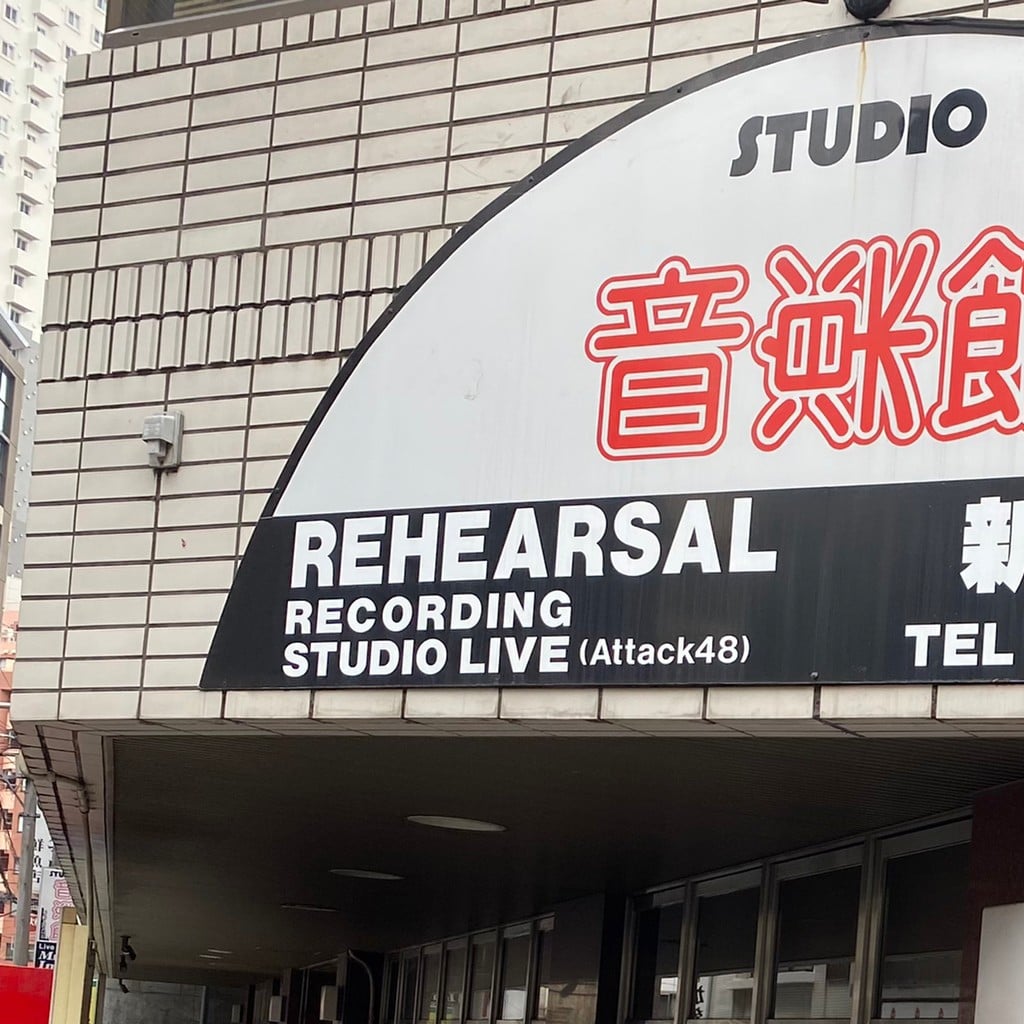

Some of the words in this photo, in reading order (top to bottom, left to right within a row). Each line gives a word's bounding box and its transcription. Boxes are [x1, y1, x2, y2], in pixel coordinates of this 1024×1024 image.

[729, 88, 987, 177] STUDIO
[291, 497, 778, 589] REHEARSAL
[284, 591, 572, 635] RECORDING
[282, 642, 447, 678] STUDIO
[459, 636, 569, 674] LIVE
[579, 634, 750, 667] (Attack48)
[904, 620, 1014, 667] TEL
